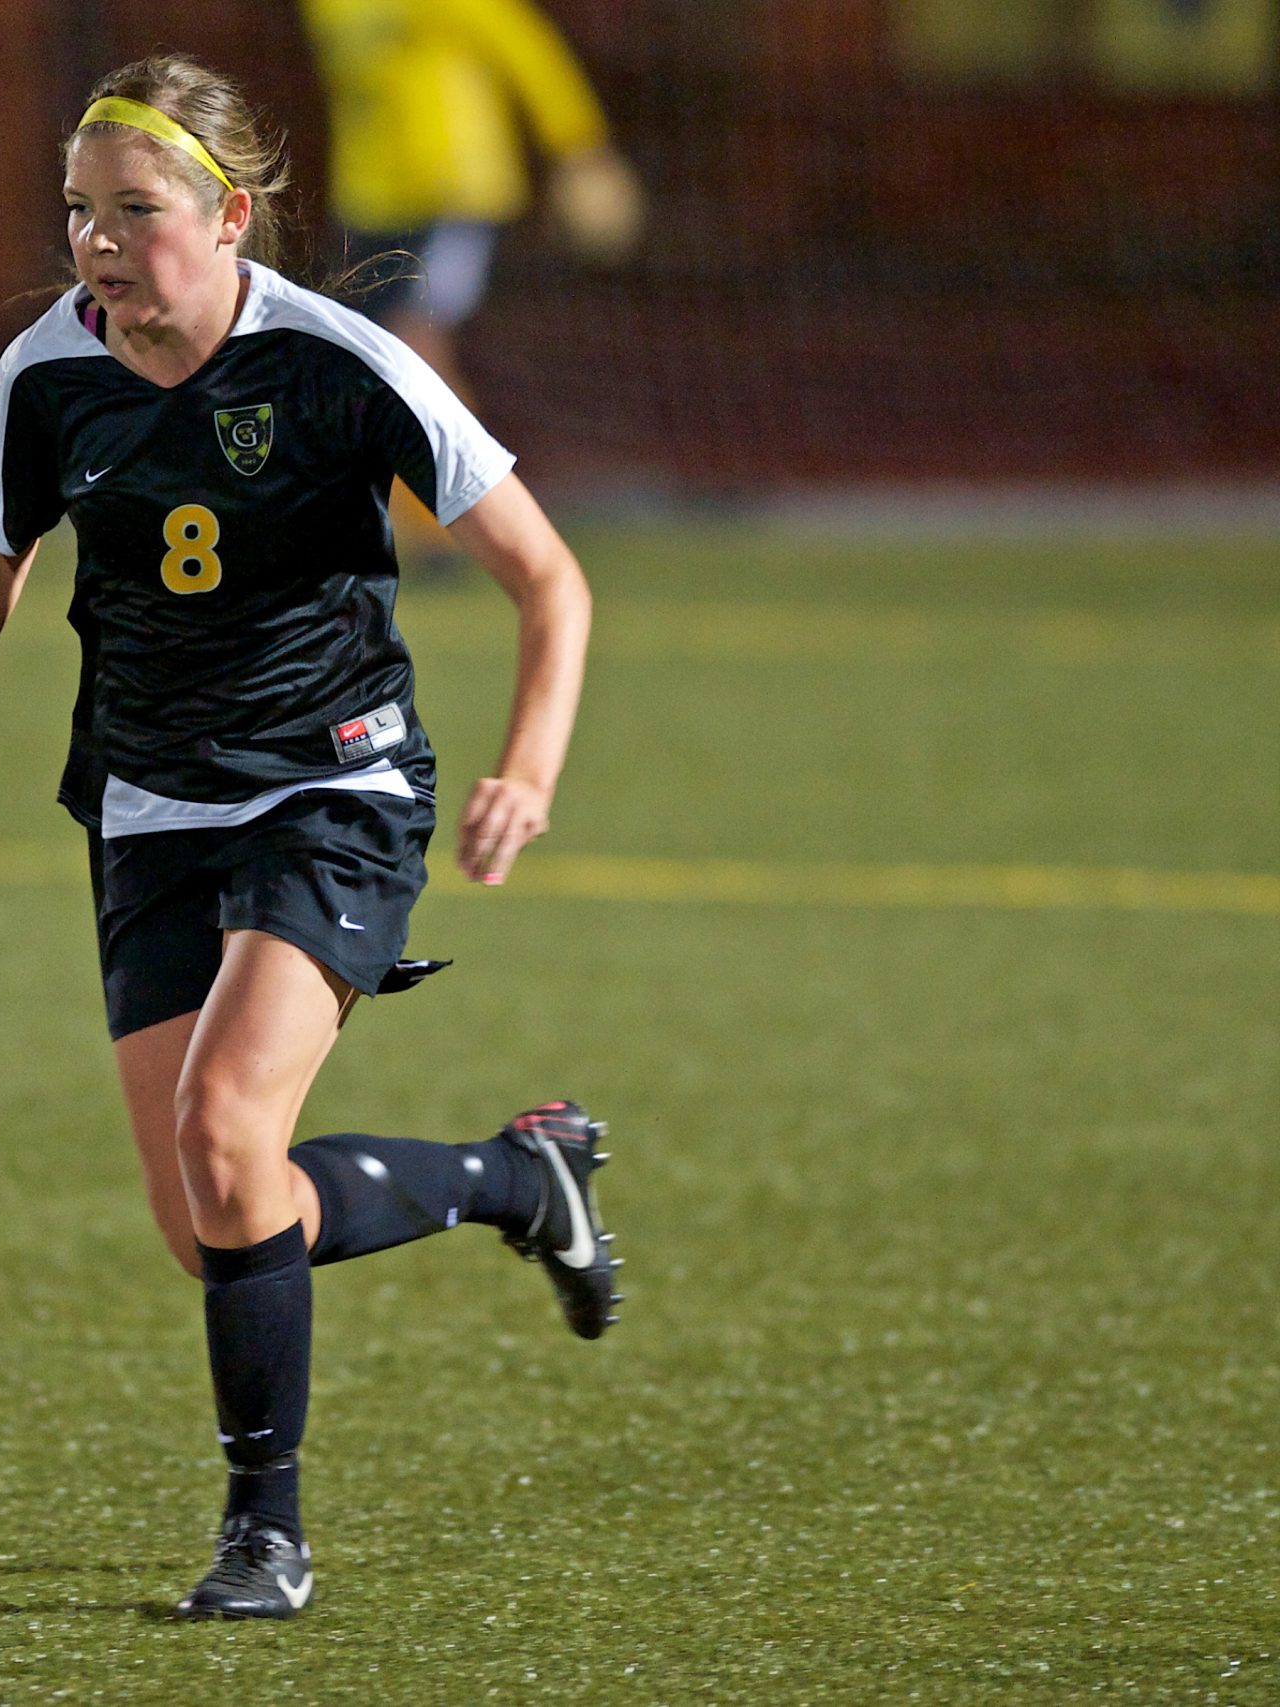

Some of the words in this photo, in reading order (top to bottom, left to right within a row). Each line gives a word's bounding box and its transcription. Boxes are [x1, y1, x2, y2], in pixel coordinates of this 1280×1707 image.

[232, 420, 257, 447] G
[160, 503, 222, 595] 8
[375, 717, 387, 727] L
